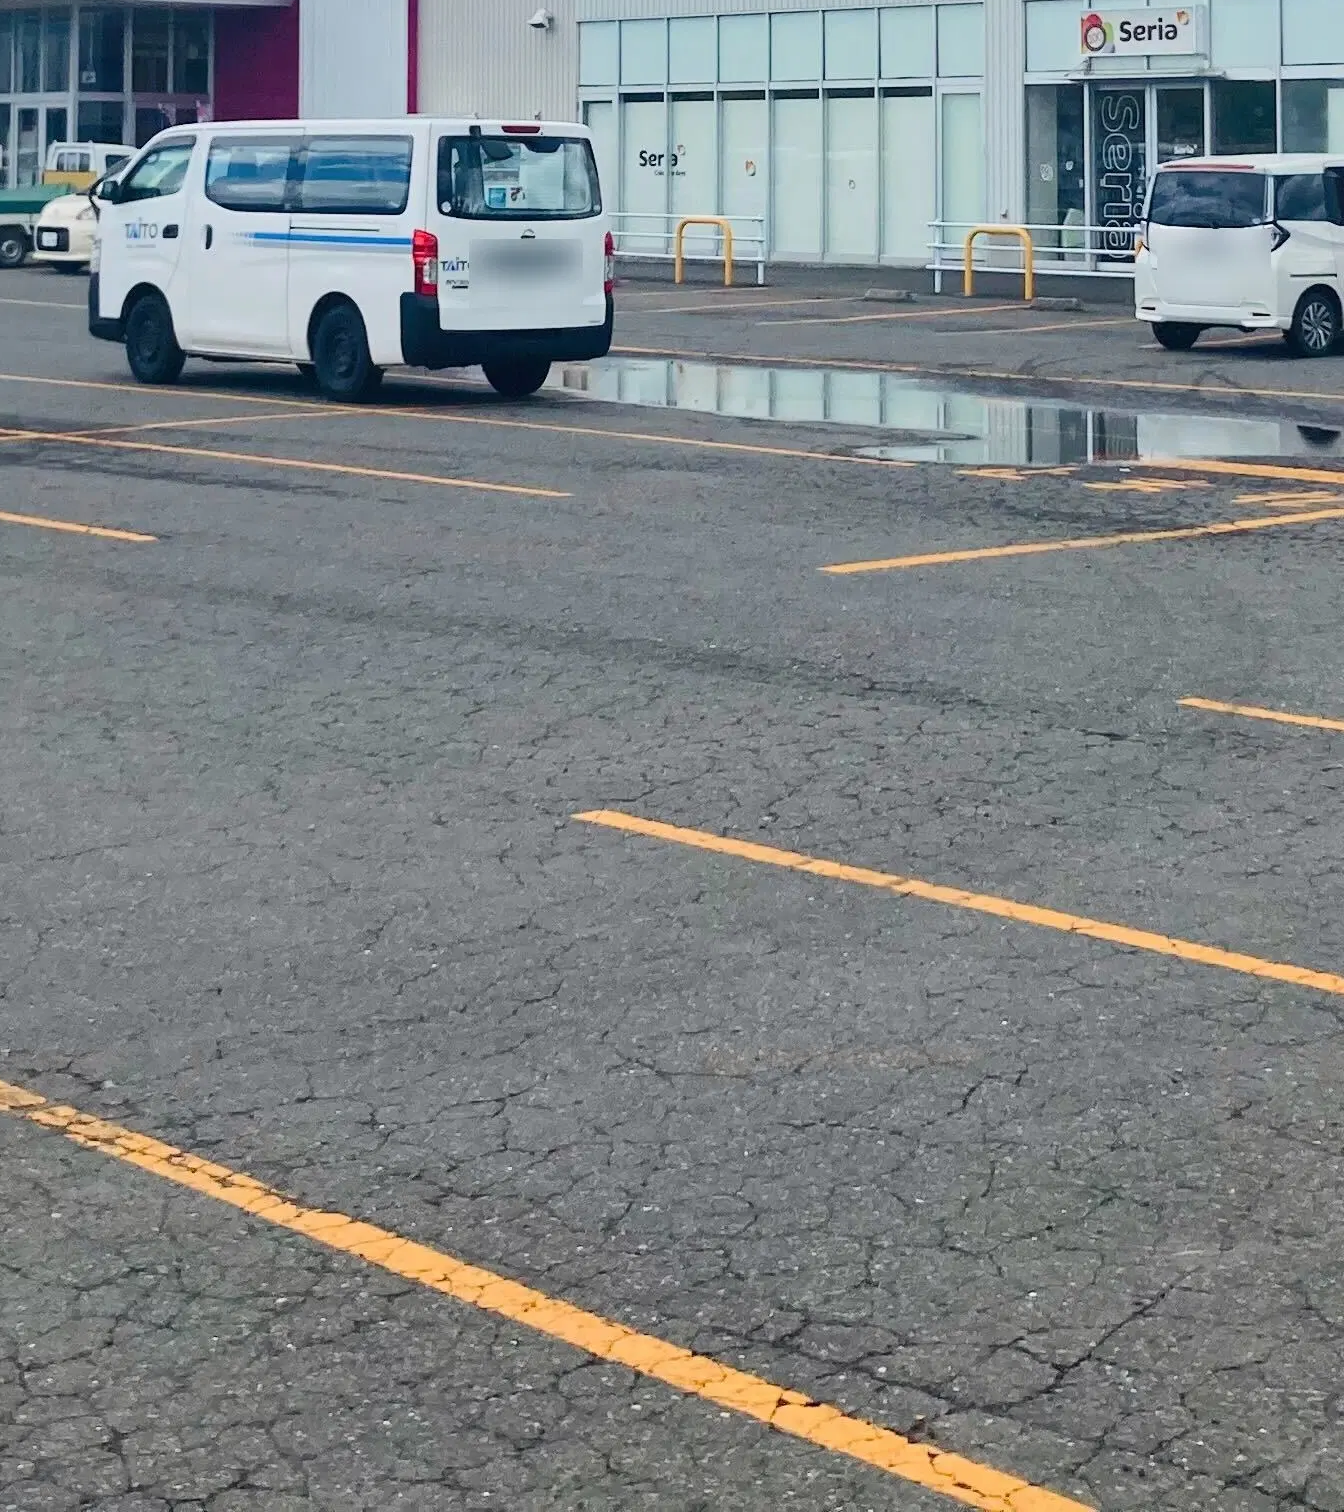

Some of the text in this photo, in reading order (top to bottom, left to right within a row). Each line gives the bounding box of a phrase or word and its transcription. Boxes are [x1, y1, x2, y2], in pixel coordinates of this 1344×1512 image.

[1119, 17, 1178, 42] Seria
[639, 149, 679, 167] Sera
[1101, 95, 1140, 259] Seria
[440, 256, 470, 272] TAIT
